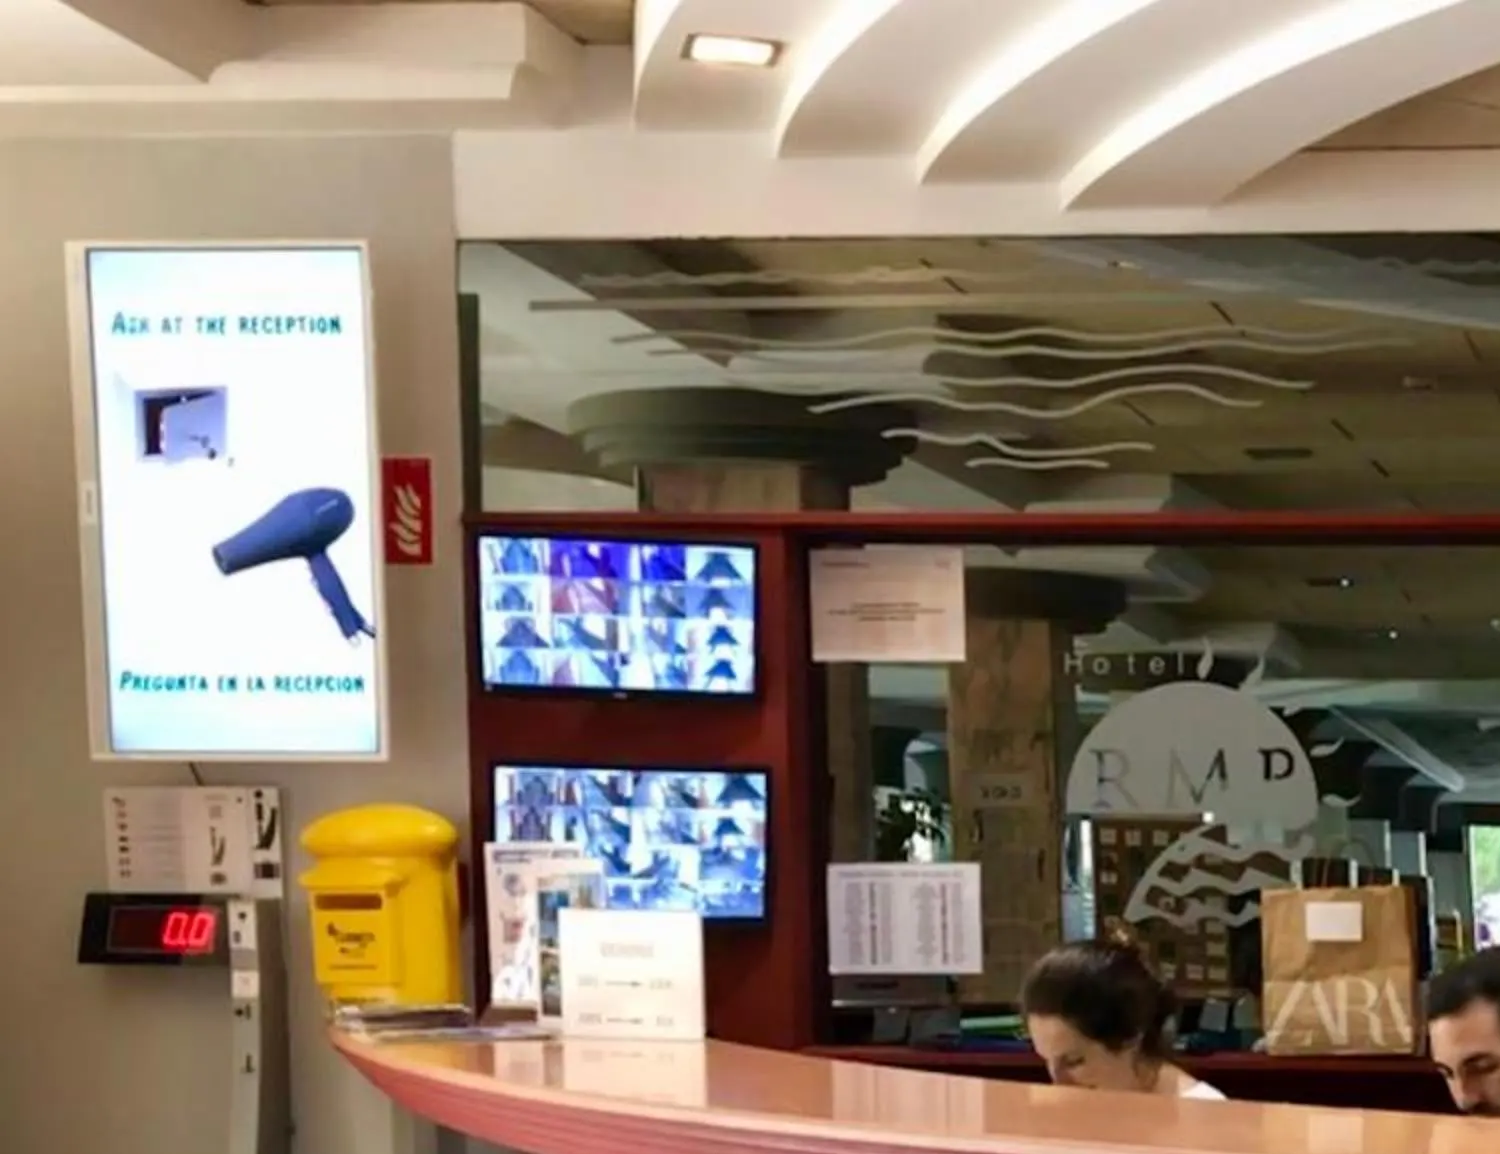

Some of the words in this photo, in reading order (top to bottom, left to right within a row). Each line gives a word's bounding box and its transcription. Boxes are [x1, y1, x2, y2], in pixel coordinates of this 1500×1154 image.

[161, 316, 183, 334] AT
[196, 316, 226, 335] THE
[238, 315, 342, 335] RECEPTION
[1063, 652, 1185, 676] Hotel
[119, 670, 209, 692] PREGUNTA
[217, 675, 238, 693] EN
[247, 675, 266, 693] LA
[1263, 975, 1414, 1047] ZARA
